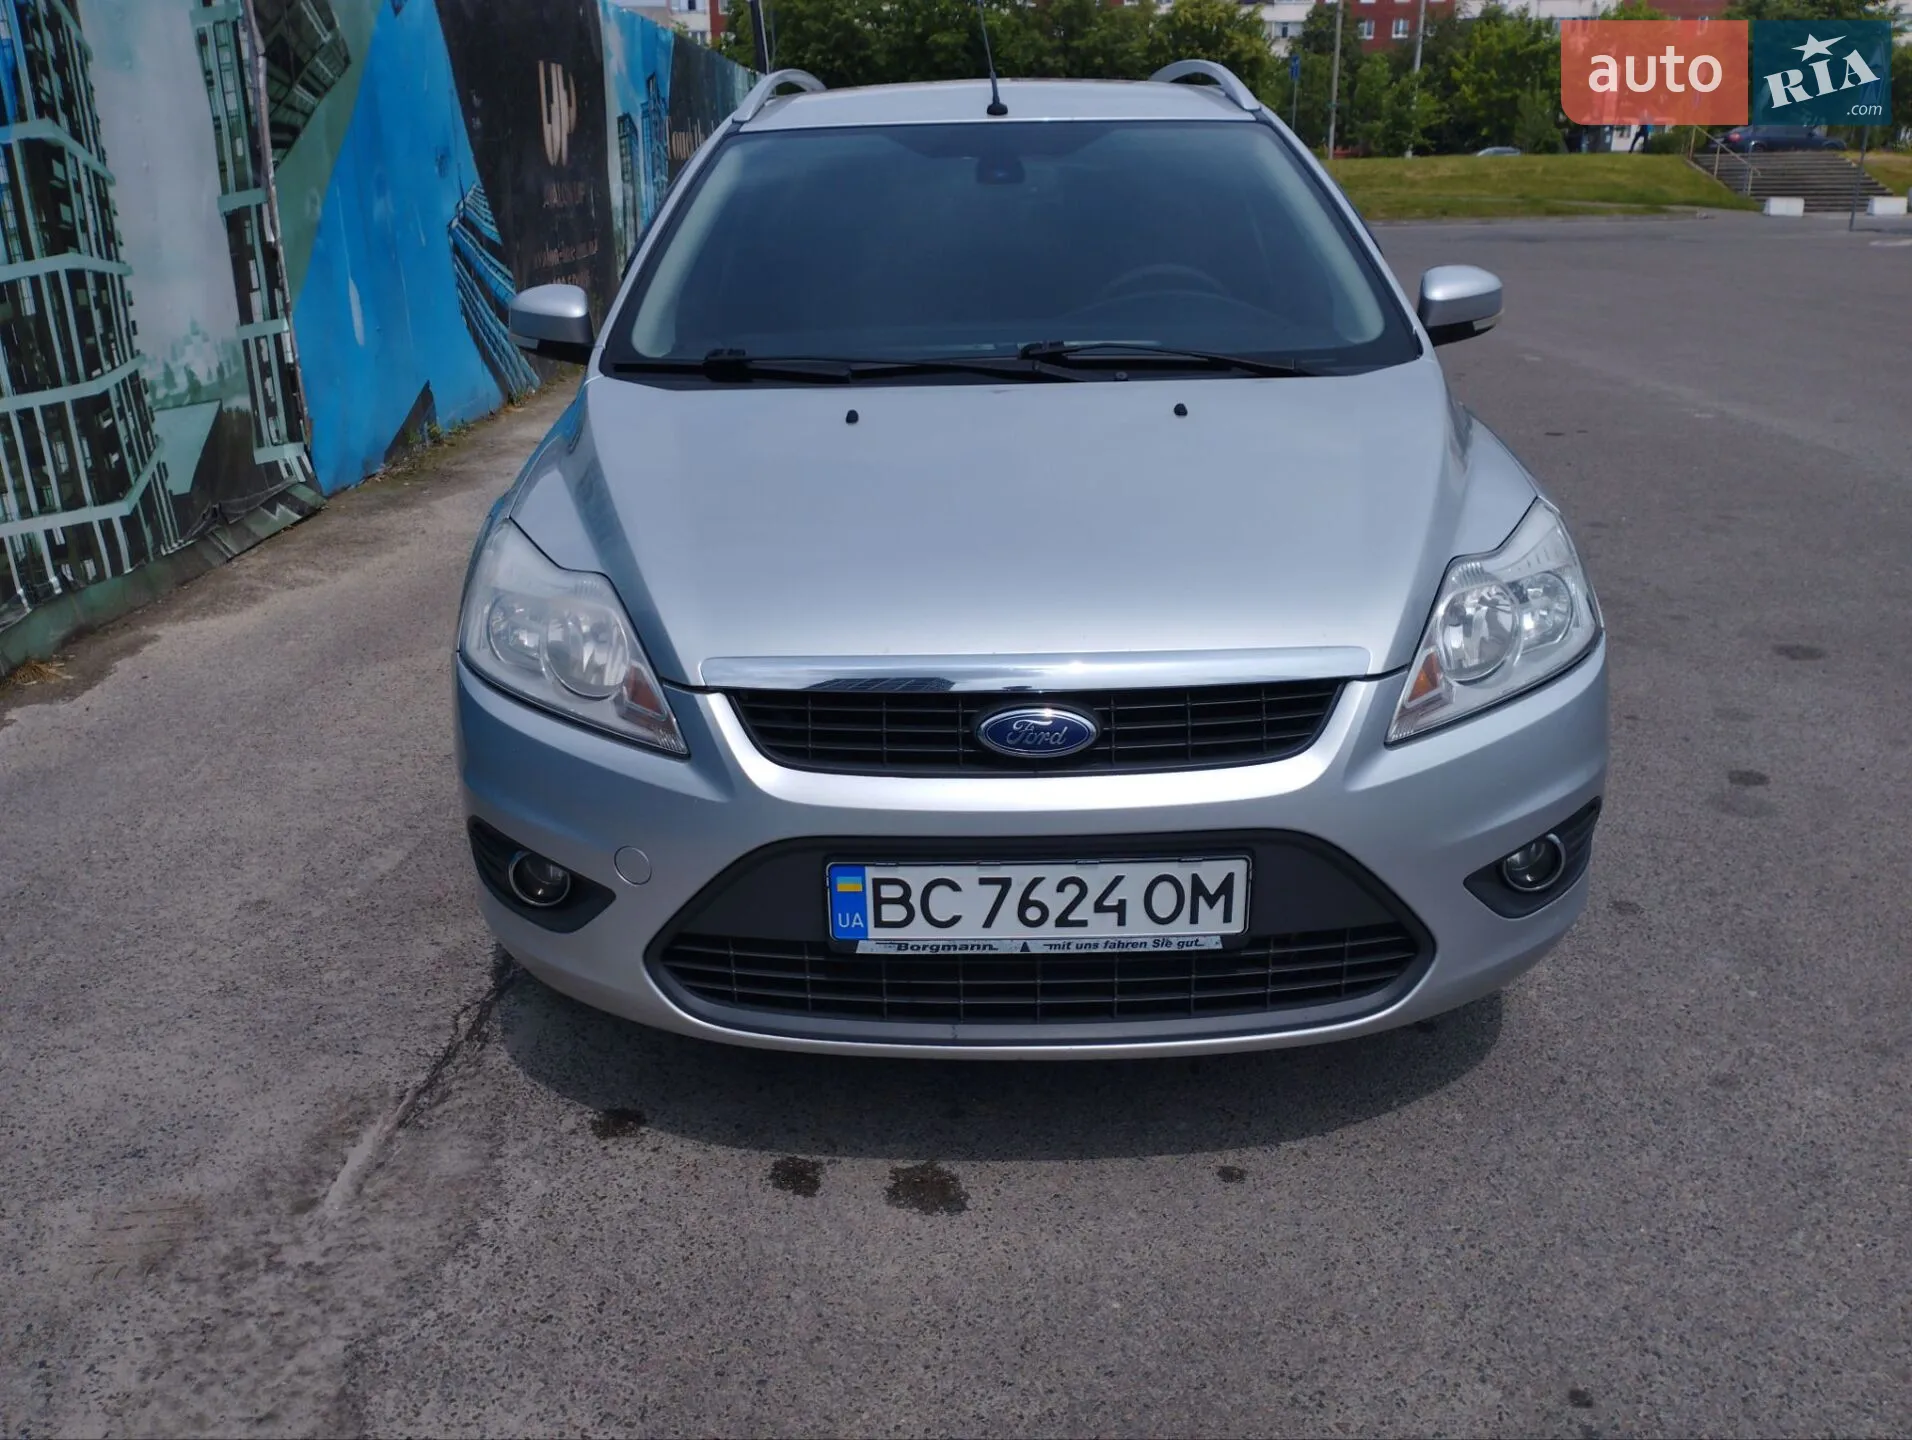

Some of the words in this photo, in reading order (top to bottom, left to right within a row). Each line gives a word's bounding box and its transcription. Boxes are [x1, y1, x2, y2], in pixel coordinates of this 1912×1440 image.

[1006, 719, 1068, 745] Ford
[871, 877, 963, 929] BC
[978, 874, 1127, 928] 7624
[1143, 872, 1235, 925] OM
[838, 912, 864, 929] UA
[896, 942, 993, 953] Borgmann
[1049, 941, 1072, 950] mit
[1075, 942, 1099, 950] uns
[1102, 939, 1148, 950] fahren
[1152, 938, 1172, 948] Sie
